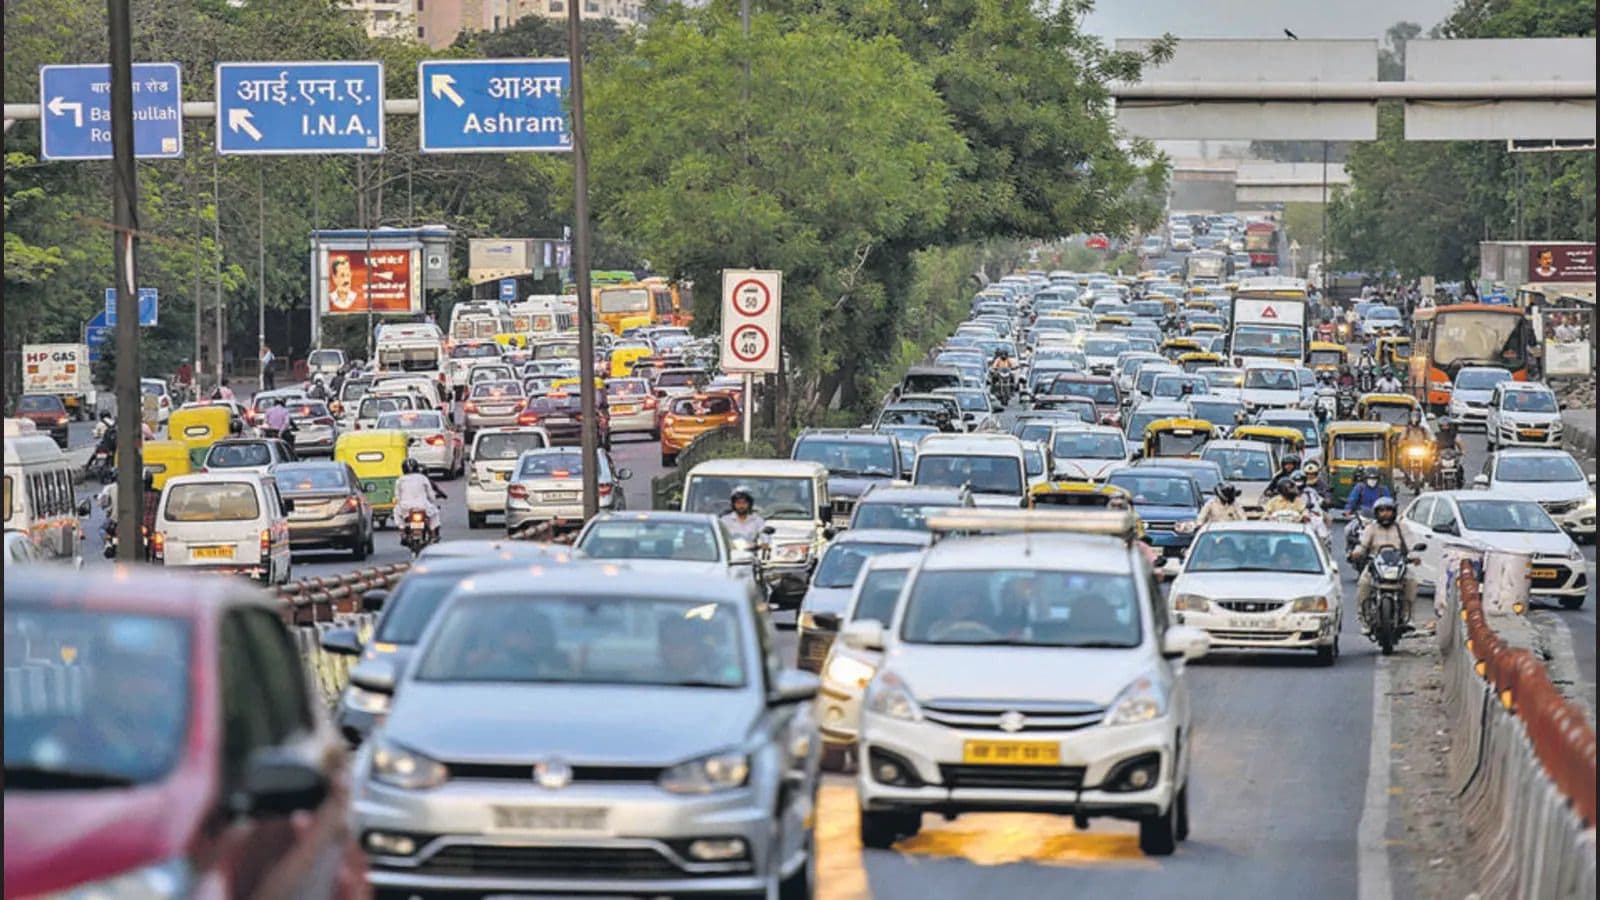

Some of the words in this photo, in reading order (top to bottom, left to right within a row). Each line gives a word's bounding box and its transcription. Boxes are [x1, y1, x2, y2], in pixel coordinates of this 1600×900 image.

[145, 78, 168, 93] रोड
[237, 71, 371, 106] आई.एन.ए.
[488, 76, 562, 99] आश्रम
[90, 106, 177, 121] Baullah
[302, 114, 372, 136] I.N.A.
[463, 112, 564, 134] Ashram
[90, 128, 111, 142] Ro
[745, 296, 758, 309] 50
[741, 343, 757, 355] 40
[26, 352, 48, 363] HP
[52, 351, 76, 362] GAS
